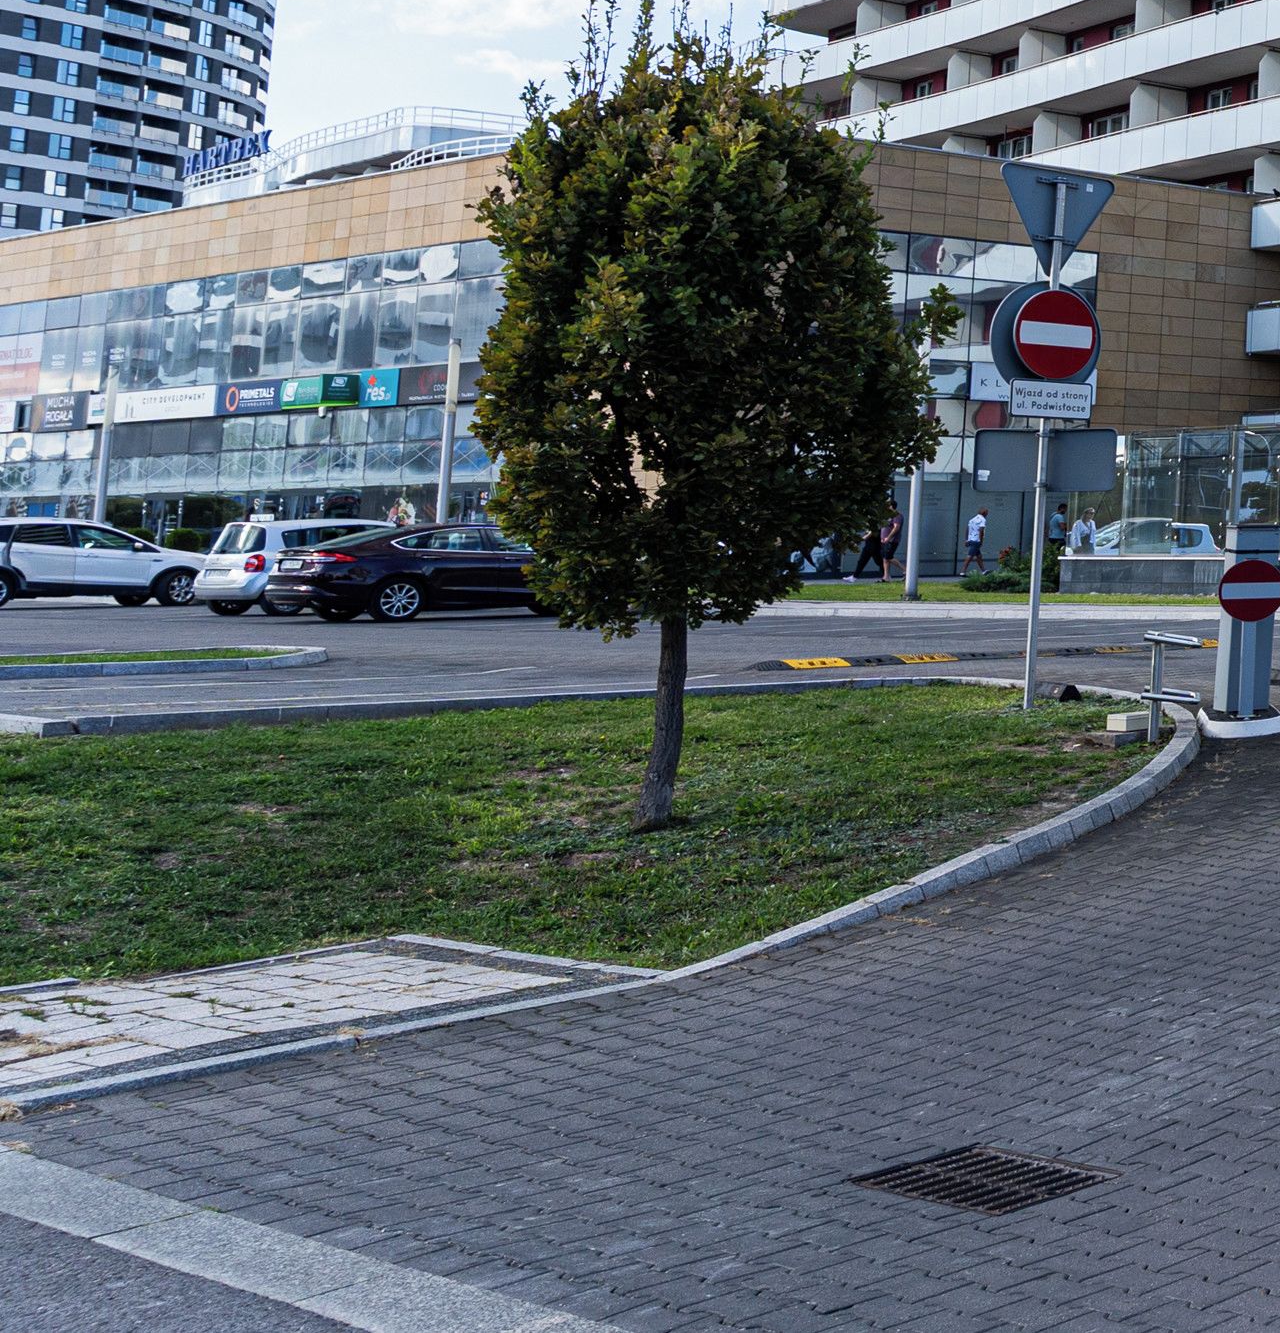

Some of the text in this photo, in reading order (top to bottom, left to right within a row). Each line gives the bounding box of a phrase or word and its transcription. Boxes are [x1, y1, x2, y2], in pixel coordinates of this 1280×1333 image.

[181, 129, 273, 178] HARTBEX
[142, 393, 206, 405] CITY DEVELOPMENT
[239, 387, 275, 399] PRIMETALS
[1014, 387, 1042, 398] Wjazd
[1046, 391, 1058, 399] od
[1061, 391, 1089, 402] strony
[47, 395, 75, 408] MUCHA
[1016, 401, 1086, 413] ul. Podwisłocze
